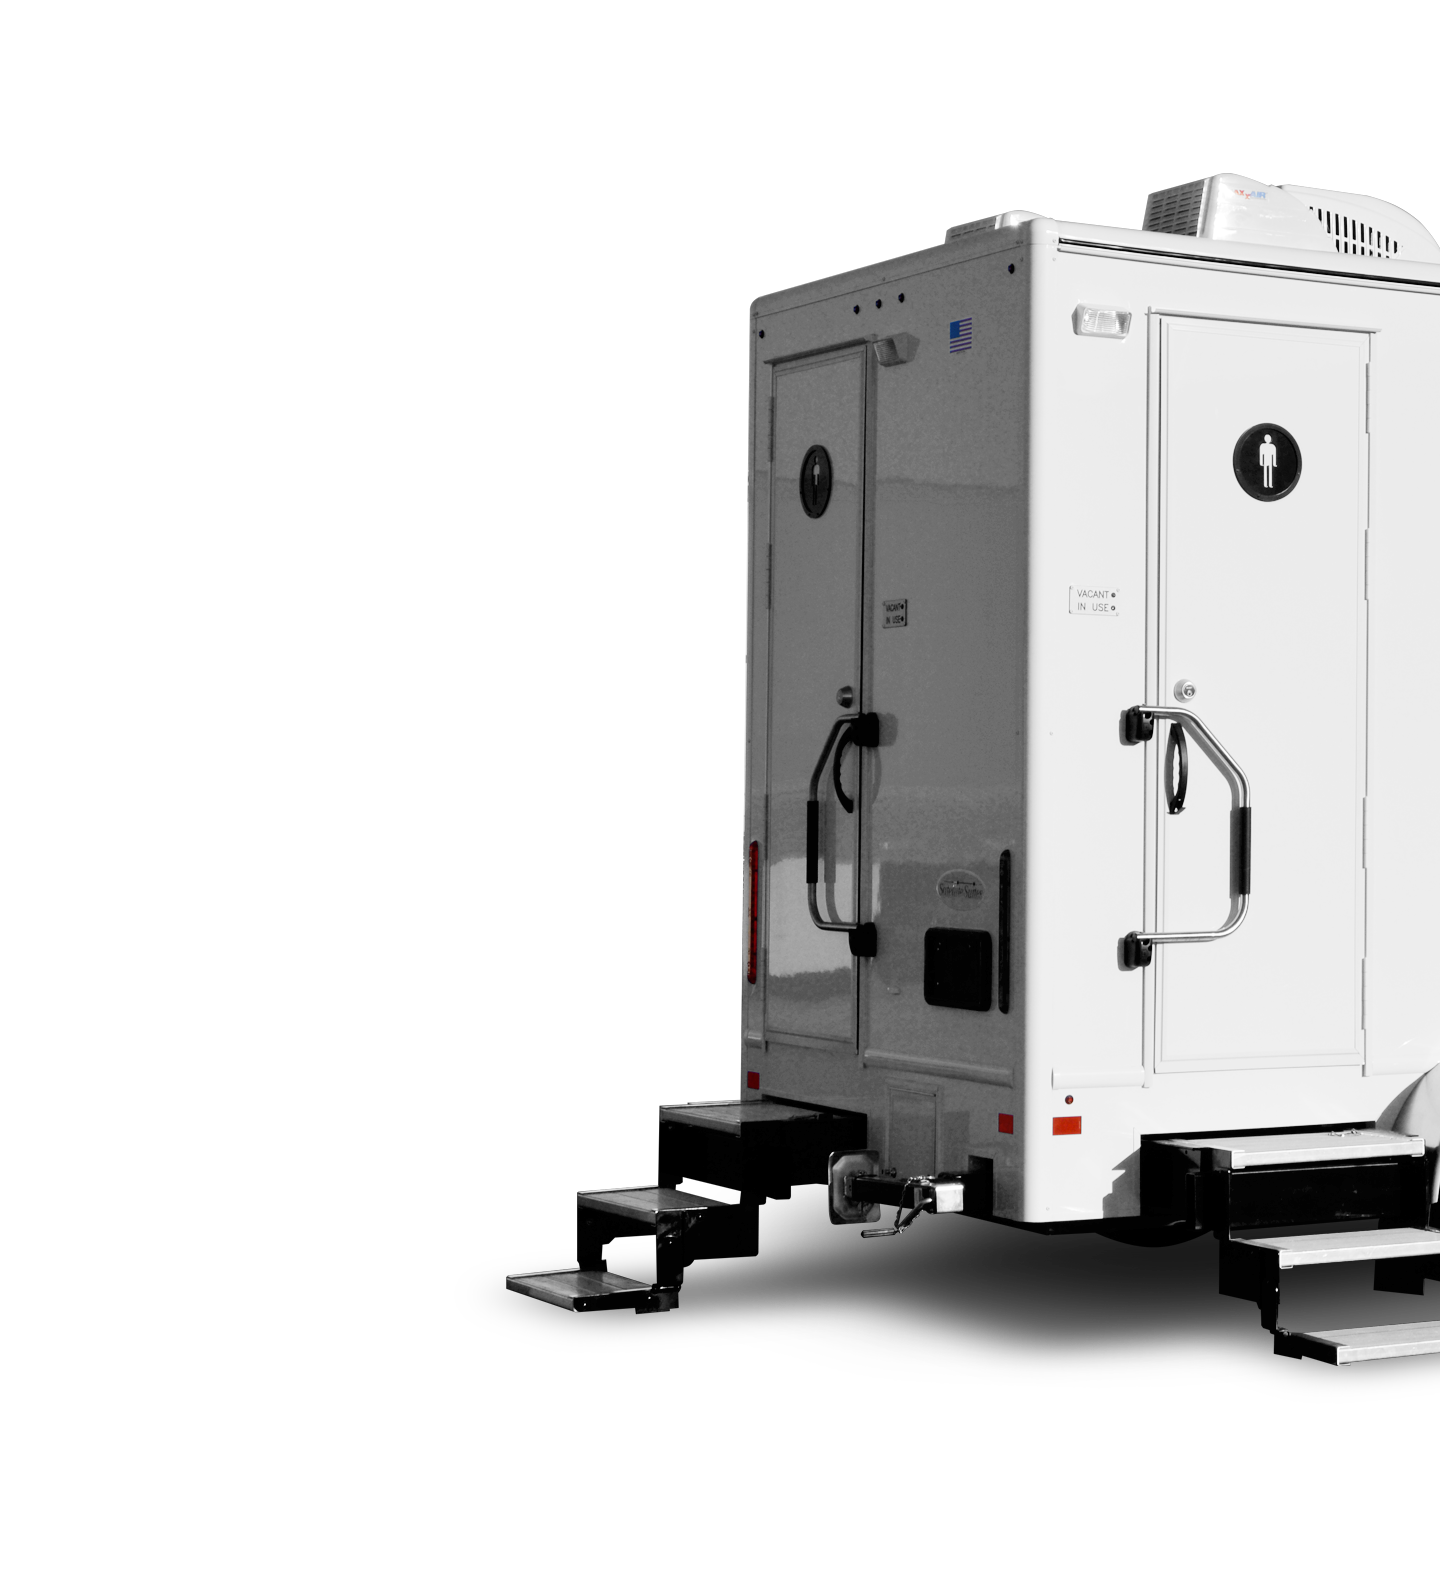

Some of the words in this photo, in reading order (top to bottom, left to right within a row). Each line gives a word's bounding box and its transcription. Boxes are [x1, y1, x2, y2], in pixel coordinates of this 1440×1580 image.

[1076, 589, 1109, 599] VACANT
[885, 602, 901, 612] VACANT
[1077, 602, 1086, 611] IN
[1092, 602, 1109, 612] USE
[885, 615, 891, 625] IN
[892, 614, 901, 624] USE
